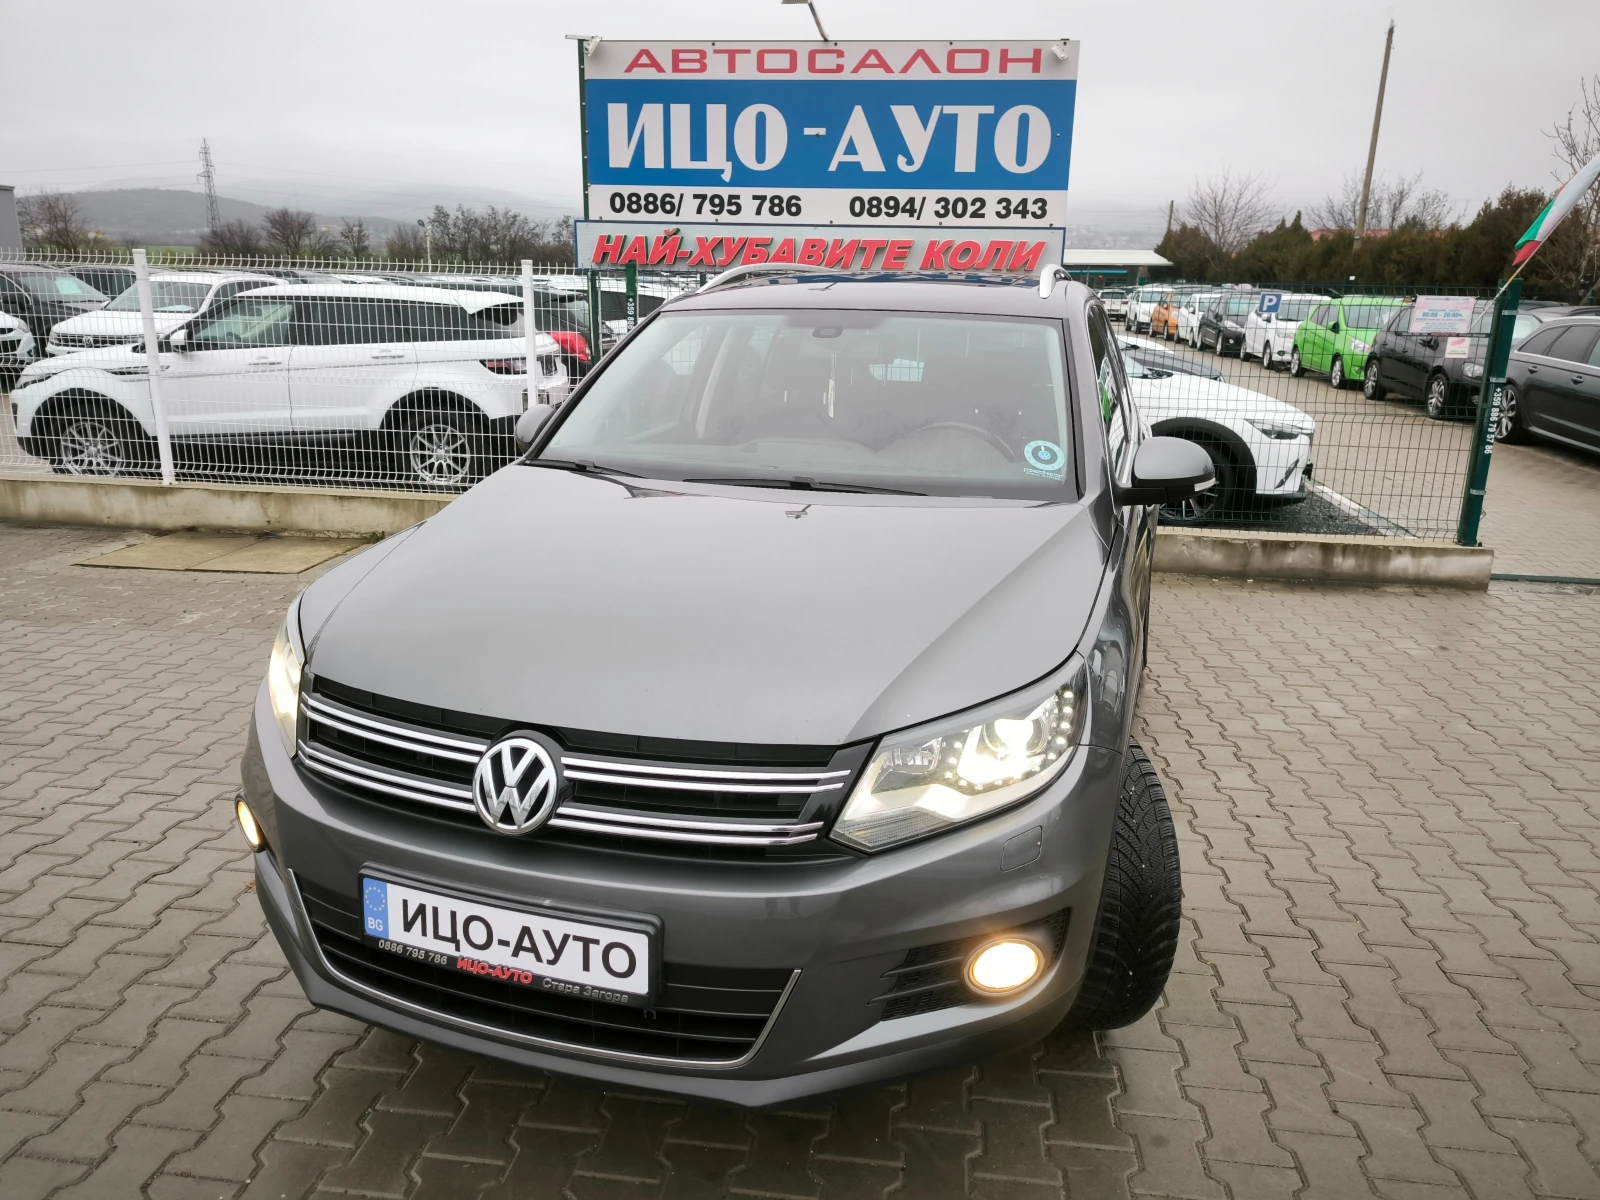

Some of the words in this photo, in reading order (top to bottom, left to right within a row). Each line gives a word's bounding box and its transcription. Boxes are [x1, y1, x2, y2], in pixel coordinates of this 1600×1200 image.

[623, 48, 1043, 75] АВТОСАЛОН
[609, 191, 684, 217] 0886/
[692, 194, 743, 216] 795
[752, 194, 802, 217] 786
[849, 195, 927, 221] 0894/
[934, 196, 987, 220] 302
[995, 197, 1048, 220] 343
[591, 227, 915, 270] НАЙ-ХУБАВИТЕ
[919, 239, 1047, 272] КОЛИ
[1262, 294, 1278, 312] P
[1492, 387, 1503, 406] +359
[1487, 422, 1497, 433] 79
[1489, 407, 1500, 422] 886
[1483, 444, 1493, 455] 86
[1485, 433, 1495, 443] 57
[367, 916, 384, 932] BG
[402, 898, 637, 979] ИЦО-АУТО
[378, 939, 403, 954] 0886
[405, 945, 425, 961] 795
[427, 950, 448, 966] 786
[456, 956, 533, 985] ИЦО-АУТО
[542, 977, 580, 995] Стара
[583, 985, 629, 1004] Загора
